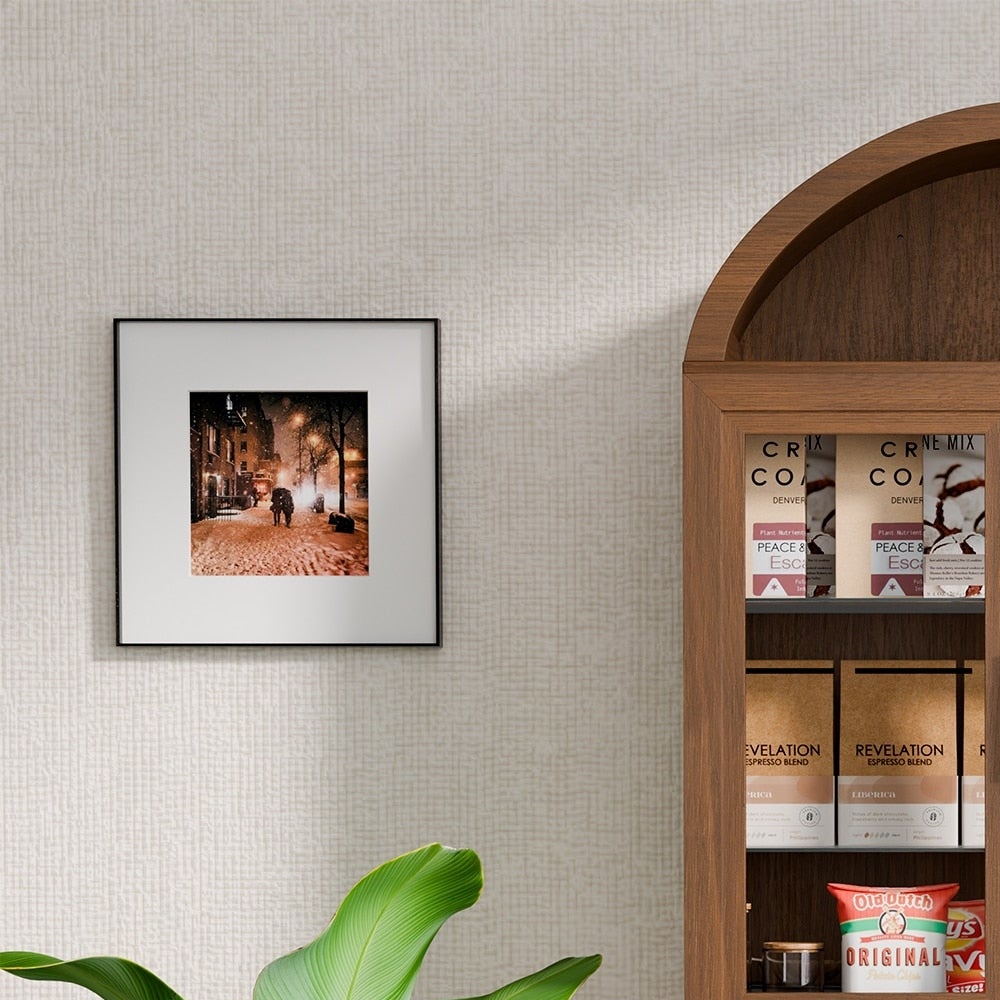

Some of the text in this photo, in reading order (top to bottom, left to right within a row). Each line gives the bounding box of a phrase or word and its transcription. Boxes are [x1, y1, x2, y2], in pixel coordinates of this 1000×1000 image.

[947, 434, 975, 450] MIX
[870, 468, 923, 486] CO
[891, 496, 923, 504] DENVER
[757, 542, 796, 553] PEACE
[876, 542, 923, 553] PEACE &
[855, 744, 944, 756] REVELATION
[784, 758, 809, 766] BLEND
[867, 758, 933, 766] ESPRESSO BLEND
[854, 891, 933, 911] Old Dutch
[846, 947, 941, 966] ORIGINAL
